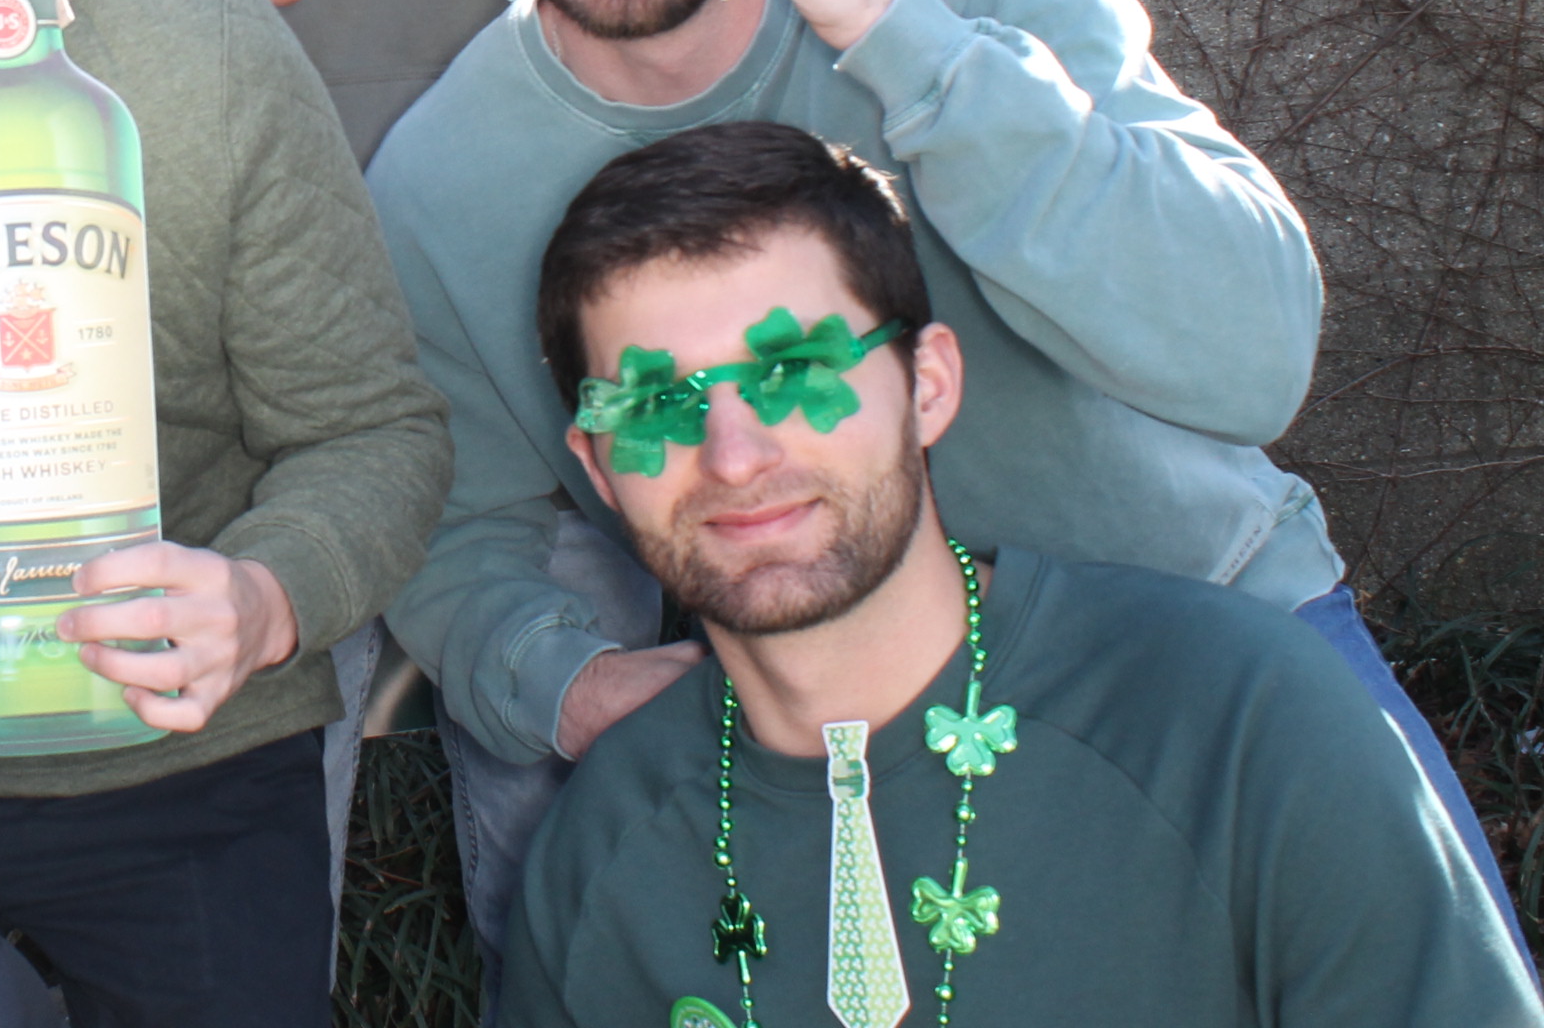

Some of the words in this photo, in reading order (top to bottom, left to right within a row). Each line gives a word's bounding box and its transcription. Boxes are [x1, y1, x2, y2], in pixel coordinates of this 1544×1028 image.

[77, 325, 114, 341] 1780
[19, 399, 115, 421] DISTILLED
[19, 433, 71, 445] WHISKEY
[73, 429, 103, 441] MADE
[105, 427, 122, 437] THE
[32, 447, 58, 457] WAY
[60, 444, 93, 455] SINCE
[20, 460, 107, 480] WHISKEY
[45, 493, 84, 504] IRELAND
[0, 556, 83, 596] James
